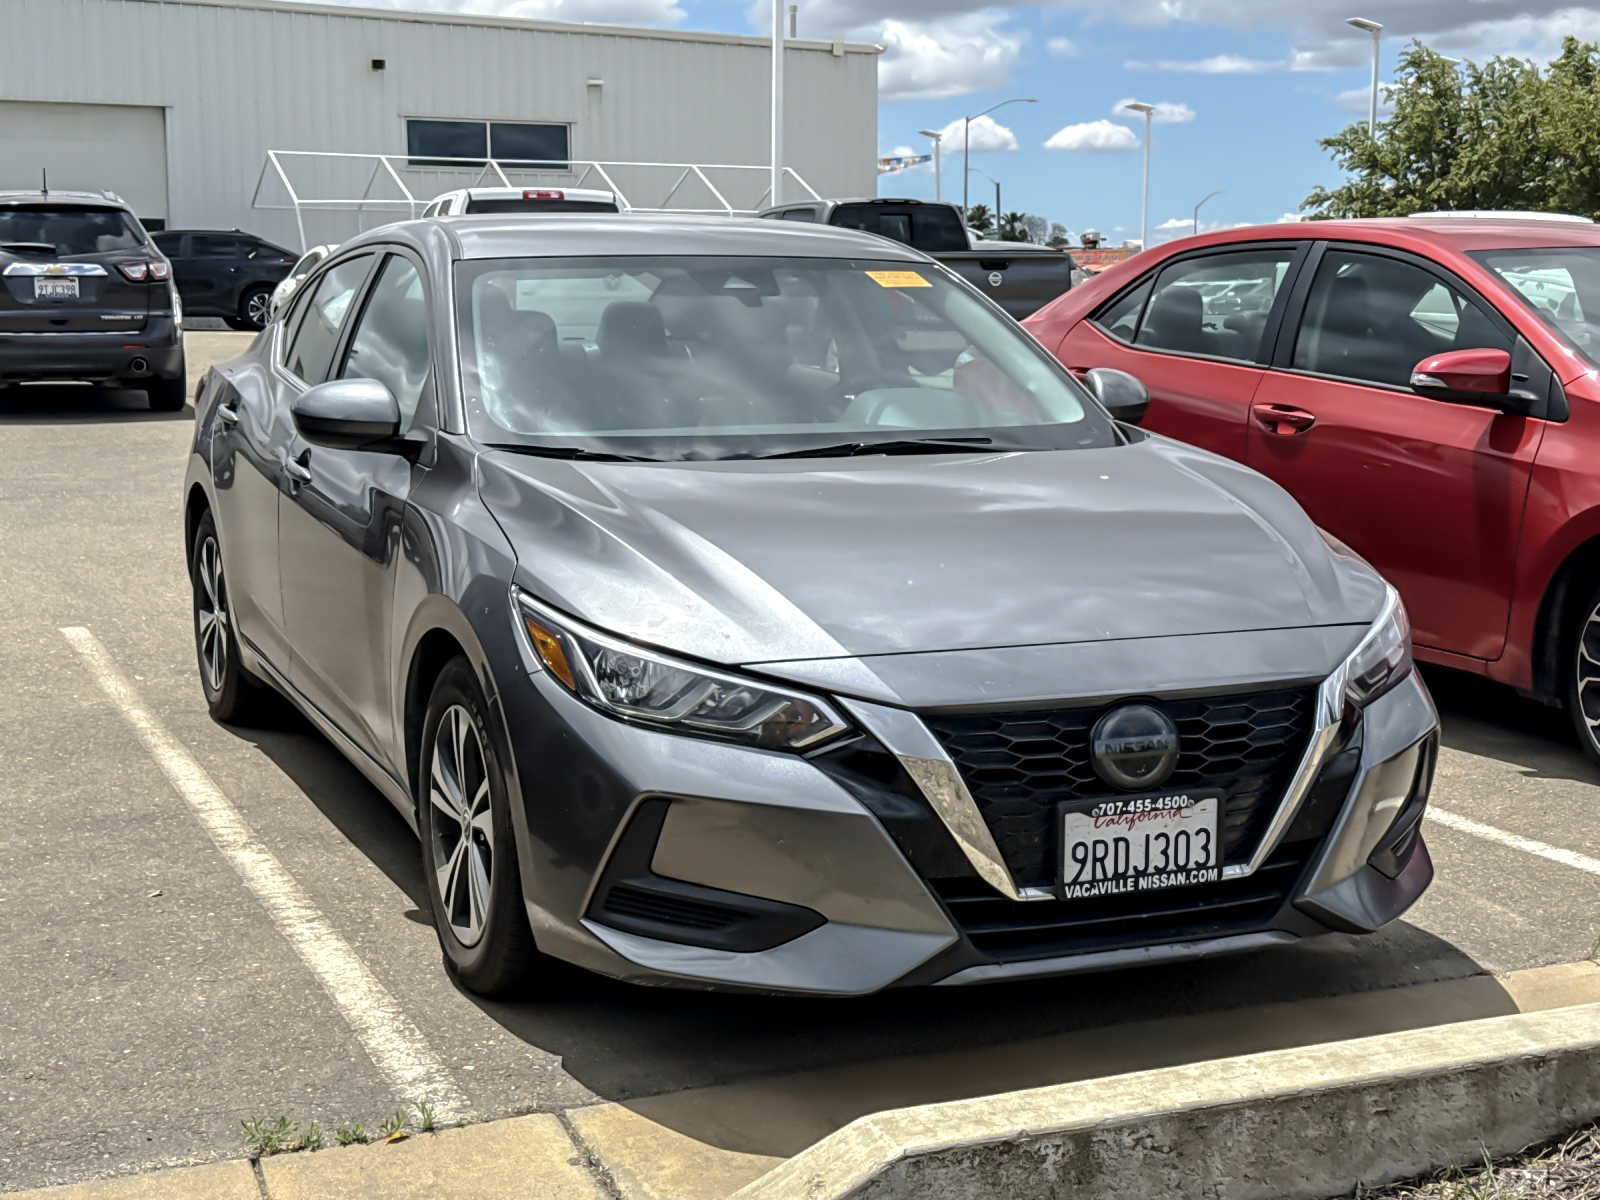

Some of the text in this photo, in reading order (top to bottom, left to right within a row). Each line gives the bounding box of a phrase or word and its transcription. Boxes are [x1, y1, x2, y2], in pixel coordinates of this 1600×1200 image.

[1104, 740, 1169, 755] NISSAN
[1099, 795, 1189, 816] 707-455-4500
[1093, 809, 1193, 832] California
[1071, 827, 1211, 883] 9RDJ303
[1065, 868, 1218, 899] VACAVILLE NISSAN.COM
